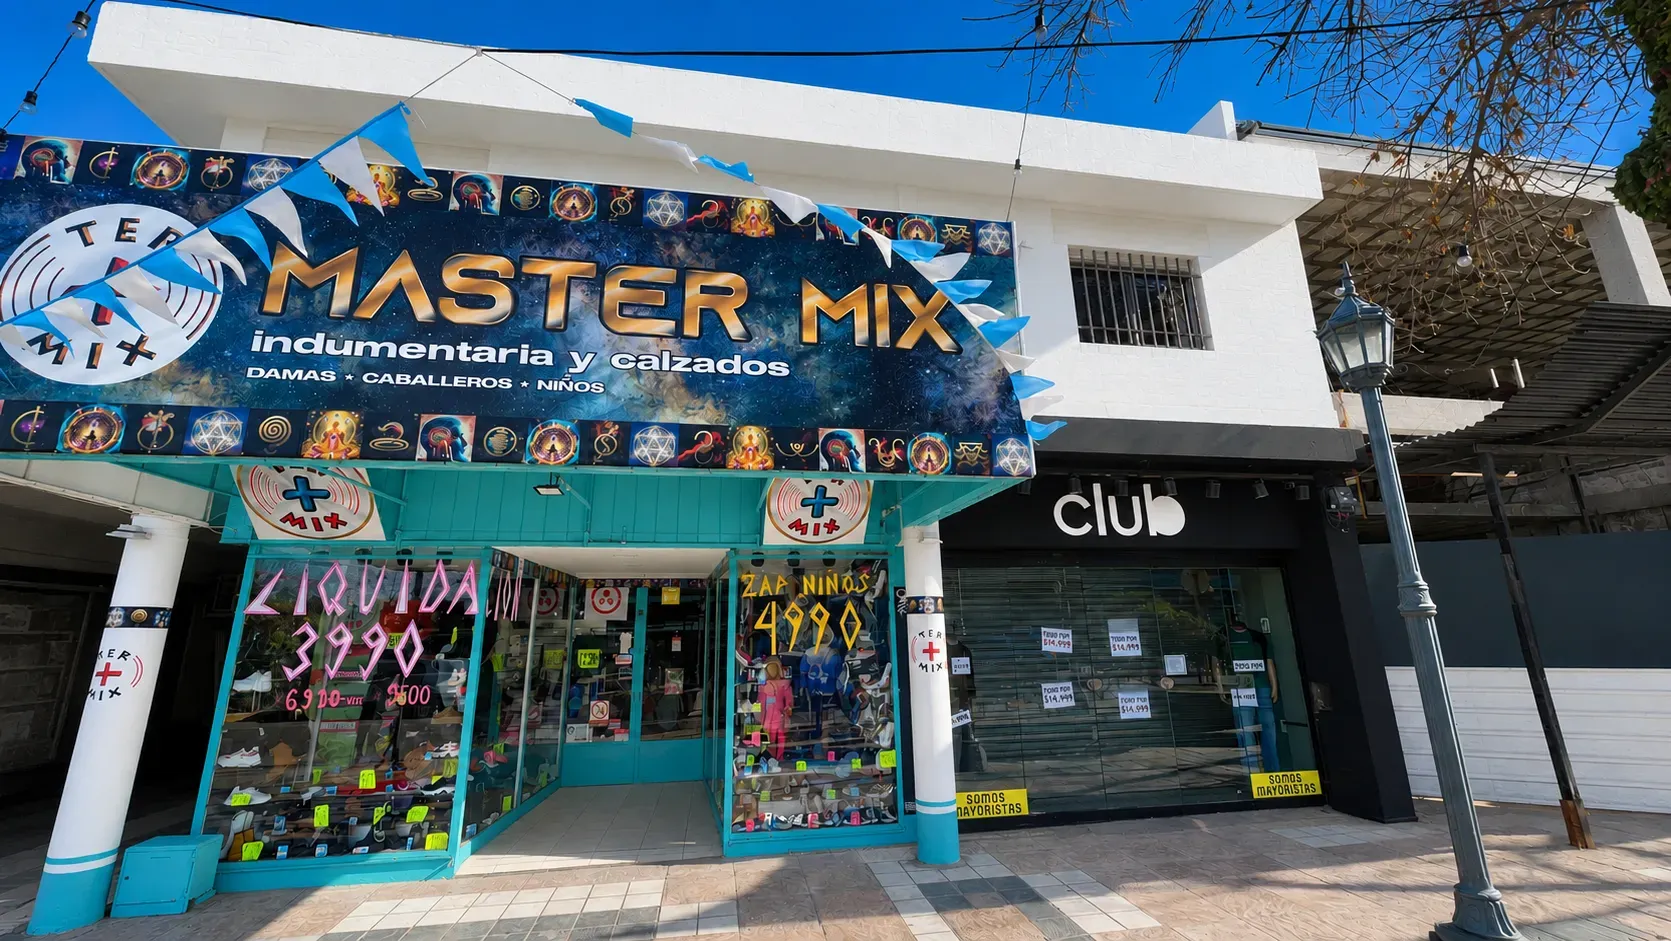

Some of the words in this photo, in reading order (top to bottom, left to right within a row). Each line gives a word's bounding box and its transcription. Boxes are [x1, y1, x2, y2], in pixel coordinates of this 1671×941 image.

[258, 241, 753, 343] MASTER
[800, 275, 965, 355] MIX
[26, 332, 157, 370] MIX
[250, 330, 555, 367] indumentaria
[567, 350, 598, 375] y
[611, 351, 791, 378] calzados
[246, 367, 338, 384] DAMAS
[362, 373, 513, 390] CABALLEROS
[536, 373, 605, 395] NIÑOS
[279, 512, 348, 532] MIX
[1053, 483, 1186, 537] club
[788, 518, 841, 536] MIX
[740, 573, 788, 598] ZAP
[803, 569, 871, 596] NIÑOS
[754, 600, 862, 656] 4990
[282, 619, 425, 682] 3990
[918, 662, 943, 673] MIX
[1257, 783, 1317, 797] MAYORISTAS
[1268, 773, 1302, 785] SOMOS
[966, 792, 1005, 805] SOMOS
